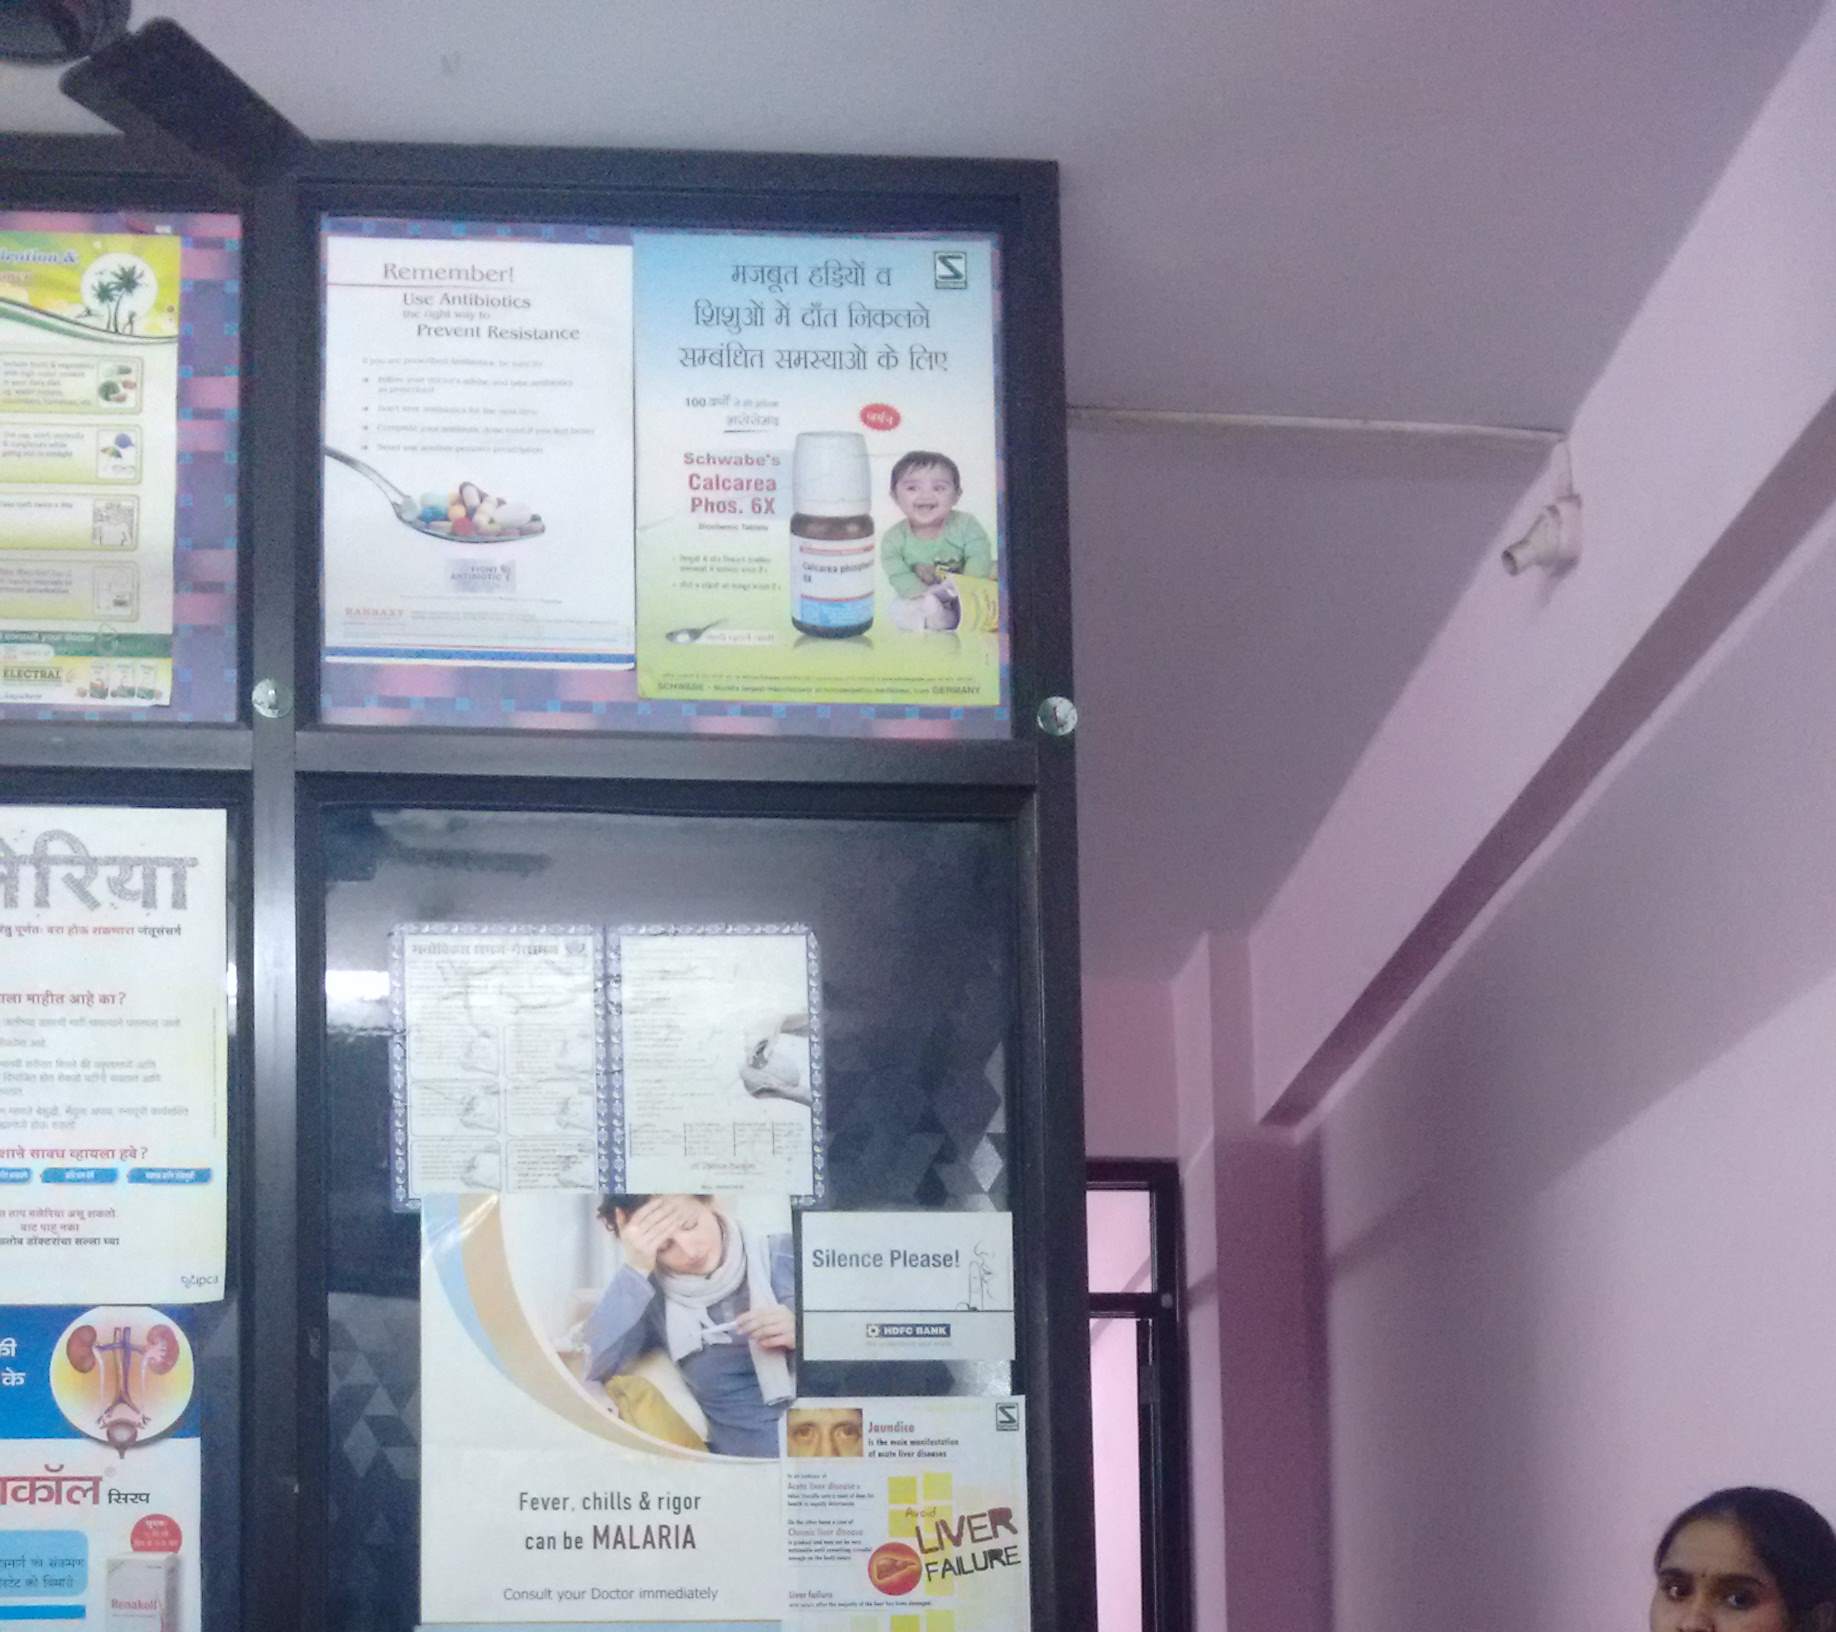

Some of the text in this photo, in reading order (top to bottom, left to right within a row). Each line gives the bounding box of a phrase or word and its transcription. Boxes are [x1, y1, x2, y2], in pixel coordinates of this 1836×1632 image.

[383, 262, 515, 283] Remember!
[730, 263, 799, 294] मजबूत
[402, 292, 531, 309] Use Antibiotics
[848, 300, 930, 329] निकलने
[416, 323, 580, 341] Prevent Resistance
[877, 343, 899, 369] के
[684, 397, 706, 408] 100
[683, 452, 782, 467] Schwabe's
[688, 472, 778, 493] Calcarea
[690, 497, 777, 515] Phos. 6X
[27, 989, 65, 1007] माहीत
[69, 990, 95, 1007] आहे
[811, 1248, 961, 1269] Silence Please!
[883, 1326, 947, 1336] HDFC BANK
[1, 1367, 26, 1386] के
[867, 1420, 916, 1434] Jaundice
[876, 1438, 889, 1446] the
[898, 1449, 915, 1458] liver
[916, 1449, 947, 1458] diseases
[107, 1487, 151, 1505] सिरप
[518, 1491, 703, 1515] Fever, chills & rigor
[905, 1506, 938, 1519] Avoid
[524, 1523, 697, 1551] can be MALARIA
[914, 1506, 1019, 1555] LIVER
[924, 1544, 1022, 1583] FAILURE
[502, 1586, 719, 1603] Consult your Doctor immediately
